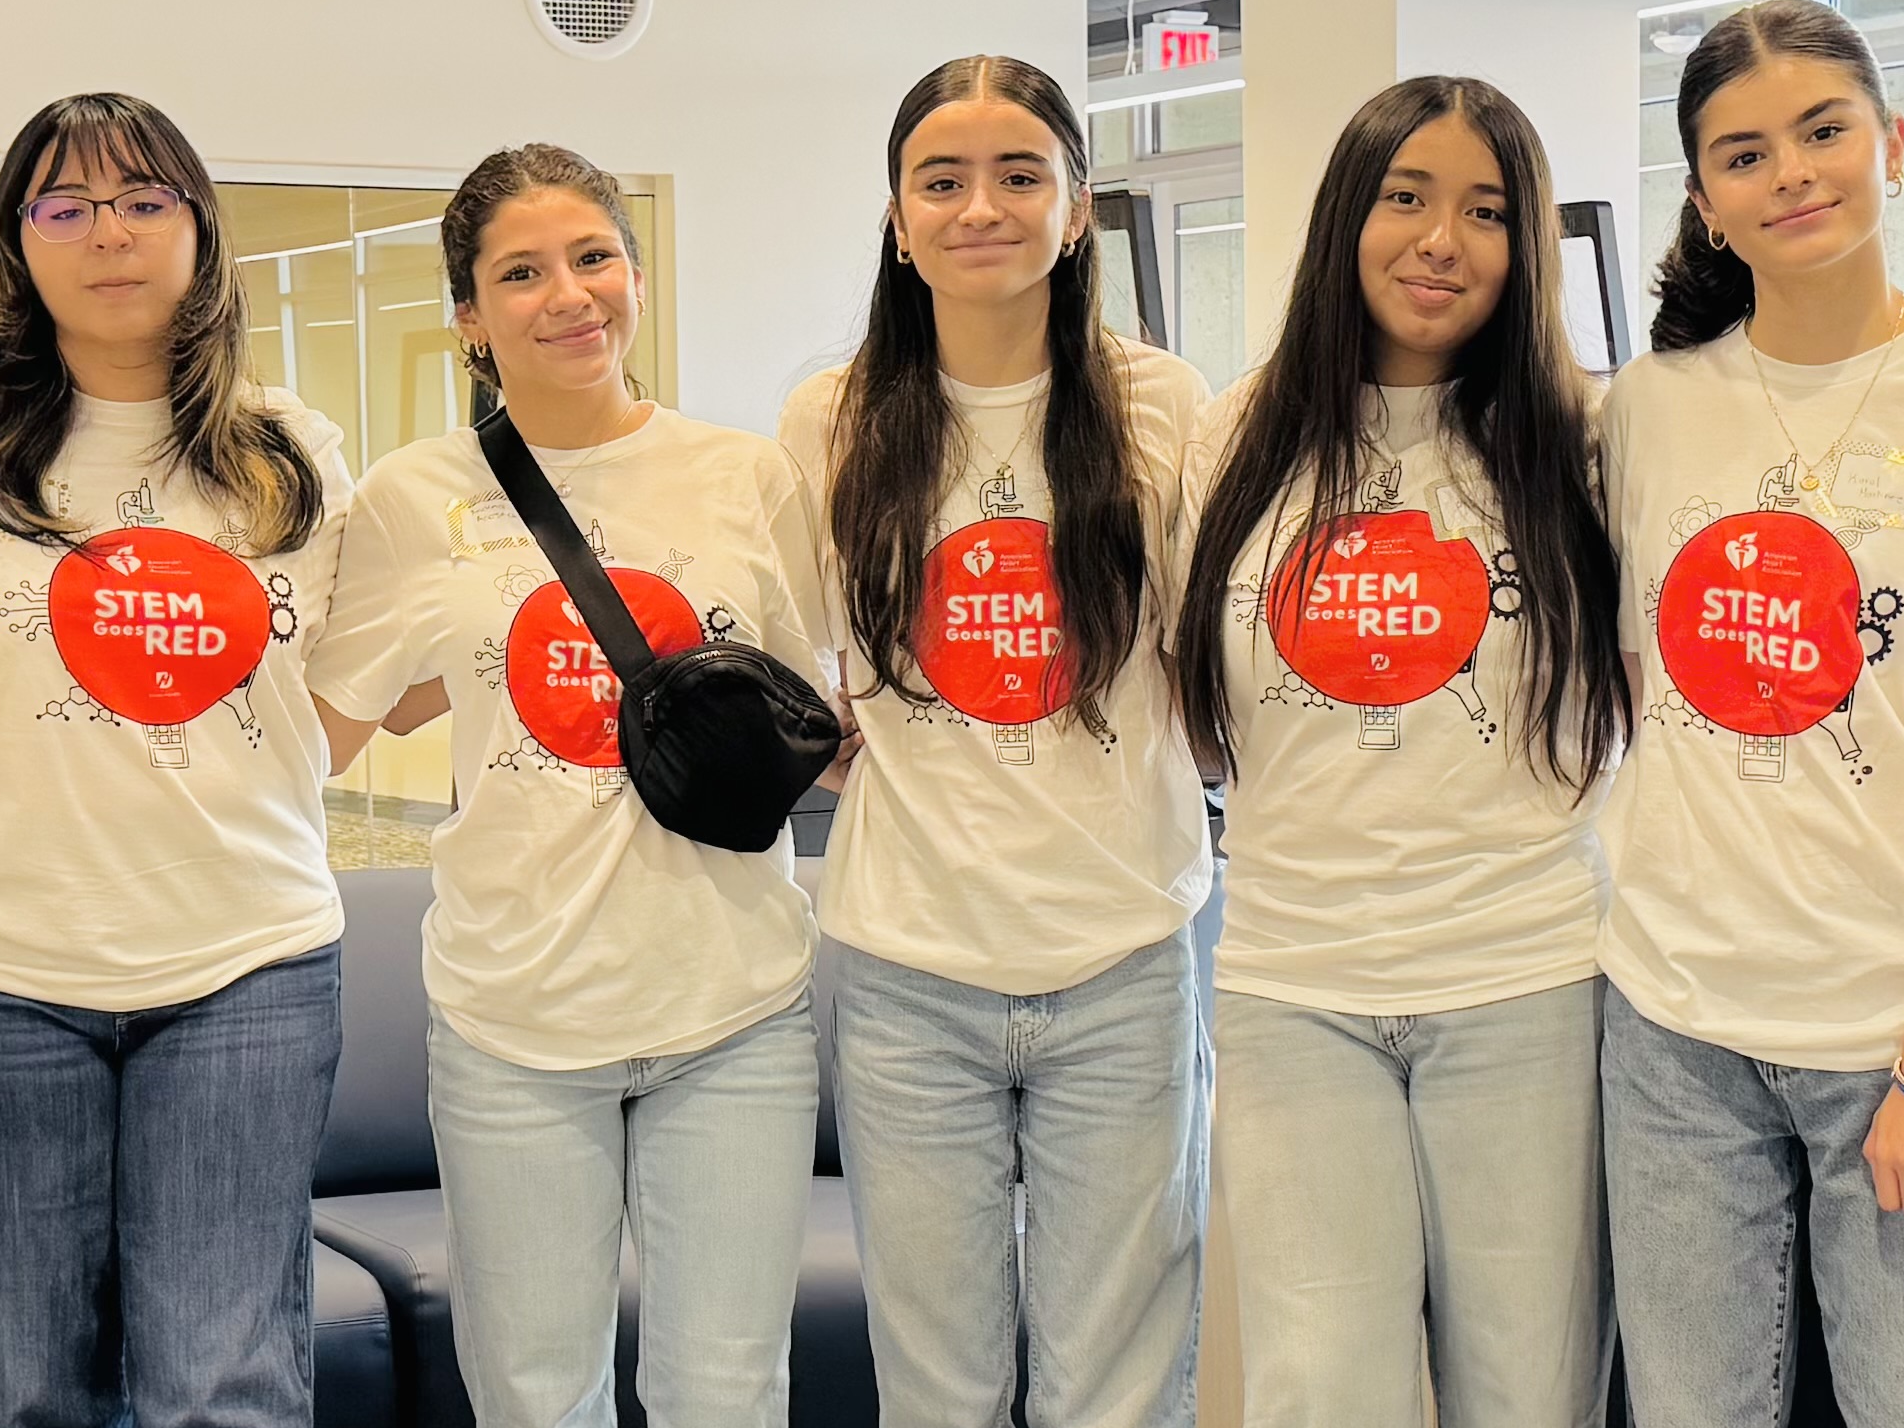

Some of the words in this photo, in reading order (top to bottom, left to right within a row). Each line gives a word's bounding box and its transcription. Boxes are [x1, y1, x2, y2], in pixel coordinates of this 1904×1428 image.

[1161, 30, 1211, 72] EXIT
[94, 588, 204, 620] STEM
[1308, 572, 1418, 604] STEM
[946, 592, 1044, 625] STEM
[1305, 606, 1357, 621] Goes
[1357, 605, 1442, 638] RED
[1701, 587, 1802, 633] STEM
[93, 620, 144, 636] Goes
[145, 624, 227, 656] RED
[945, 627, 993, 642] Goes
[1698, 623, 1746, 642] Goes
[1746, 630, 1820, 673] RED
[547, 640, 611, 671] STE
[546, 673, 590, 688] Goes
